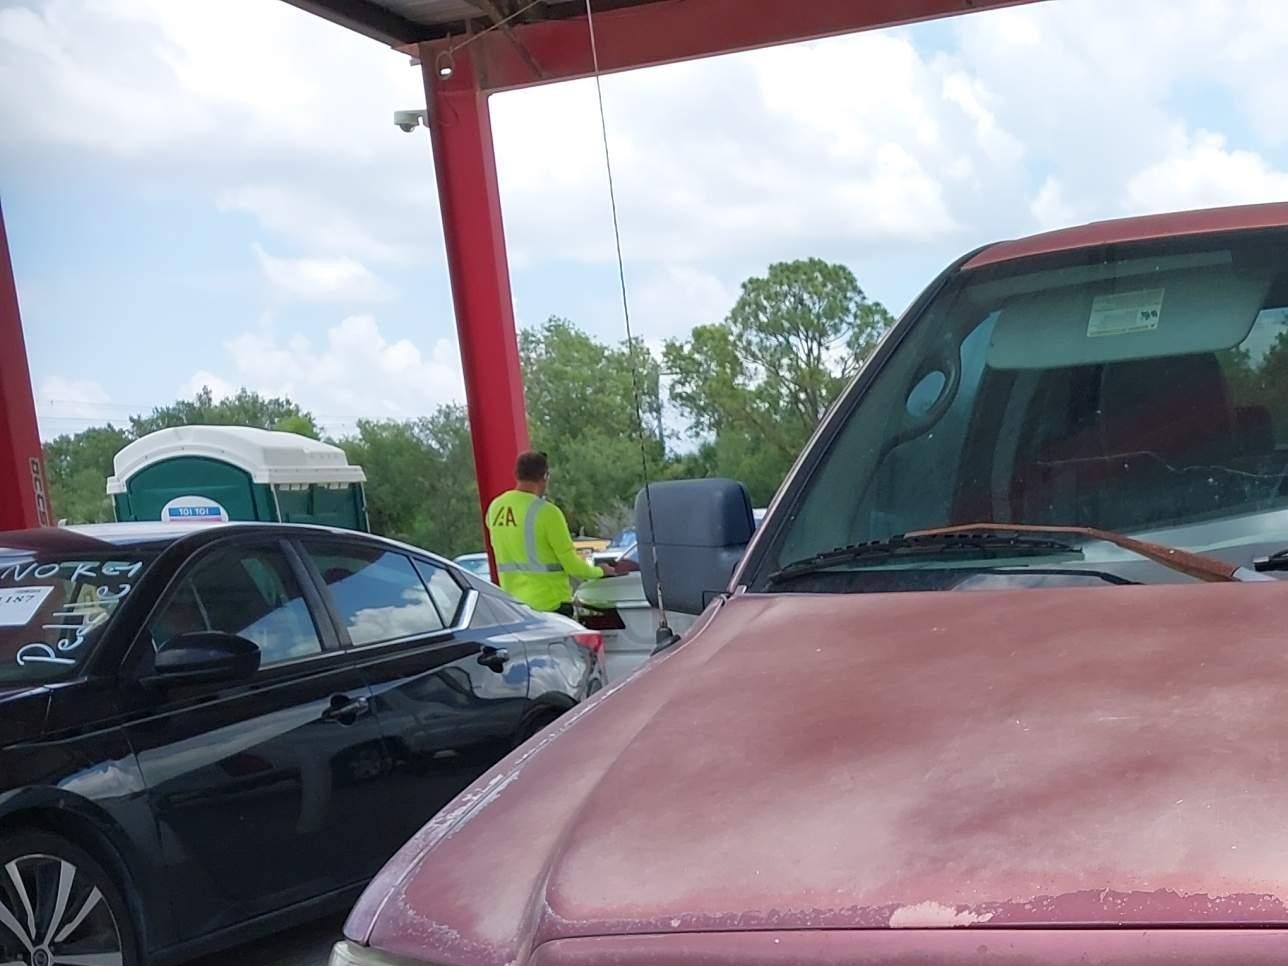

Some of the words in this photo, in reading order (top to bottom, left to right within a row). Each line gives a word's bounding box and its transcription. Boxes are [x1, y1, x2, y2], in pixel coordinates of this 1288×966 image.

[178, 507, 193, 516] TOI
[195, 506, 209, 516] TOI
[0, 562, 60, 582] NO
